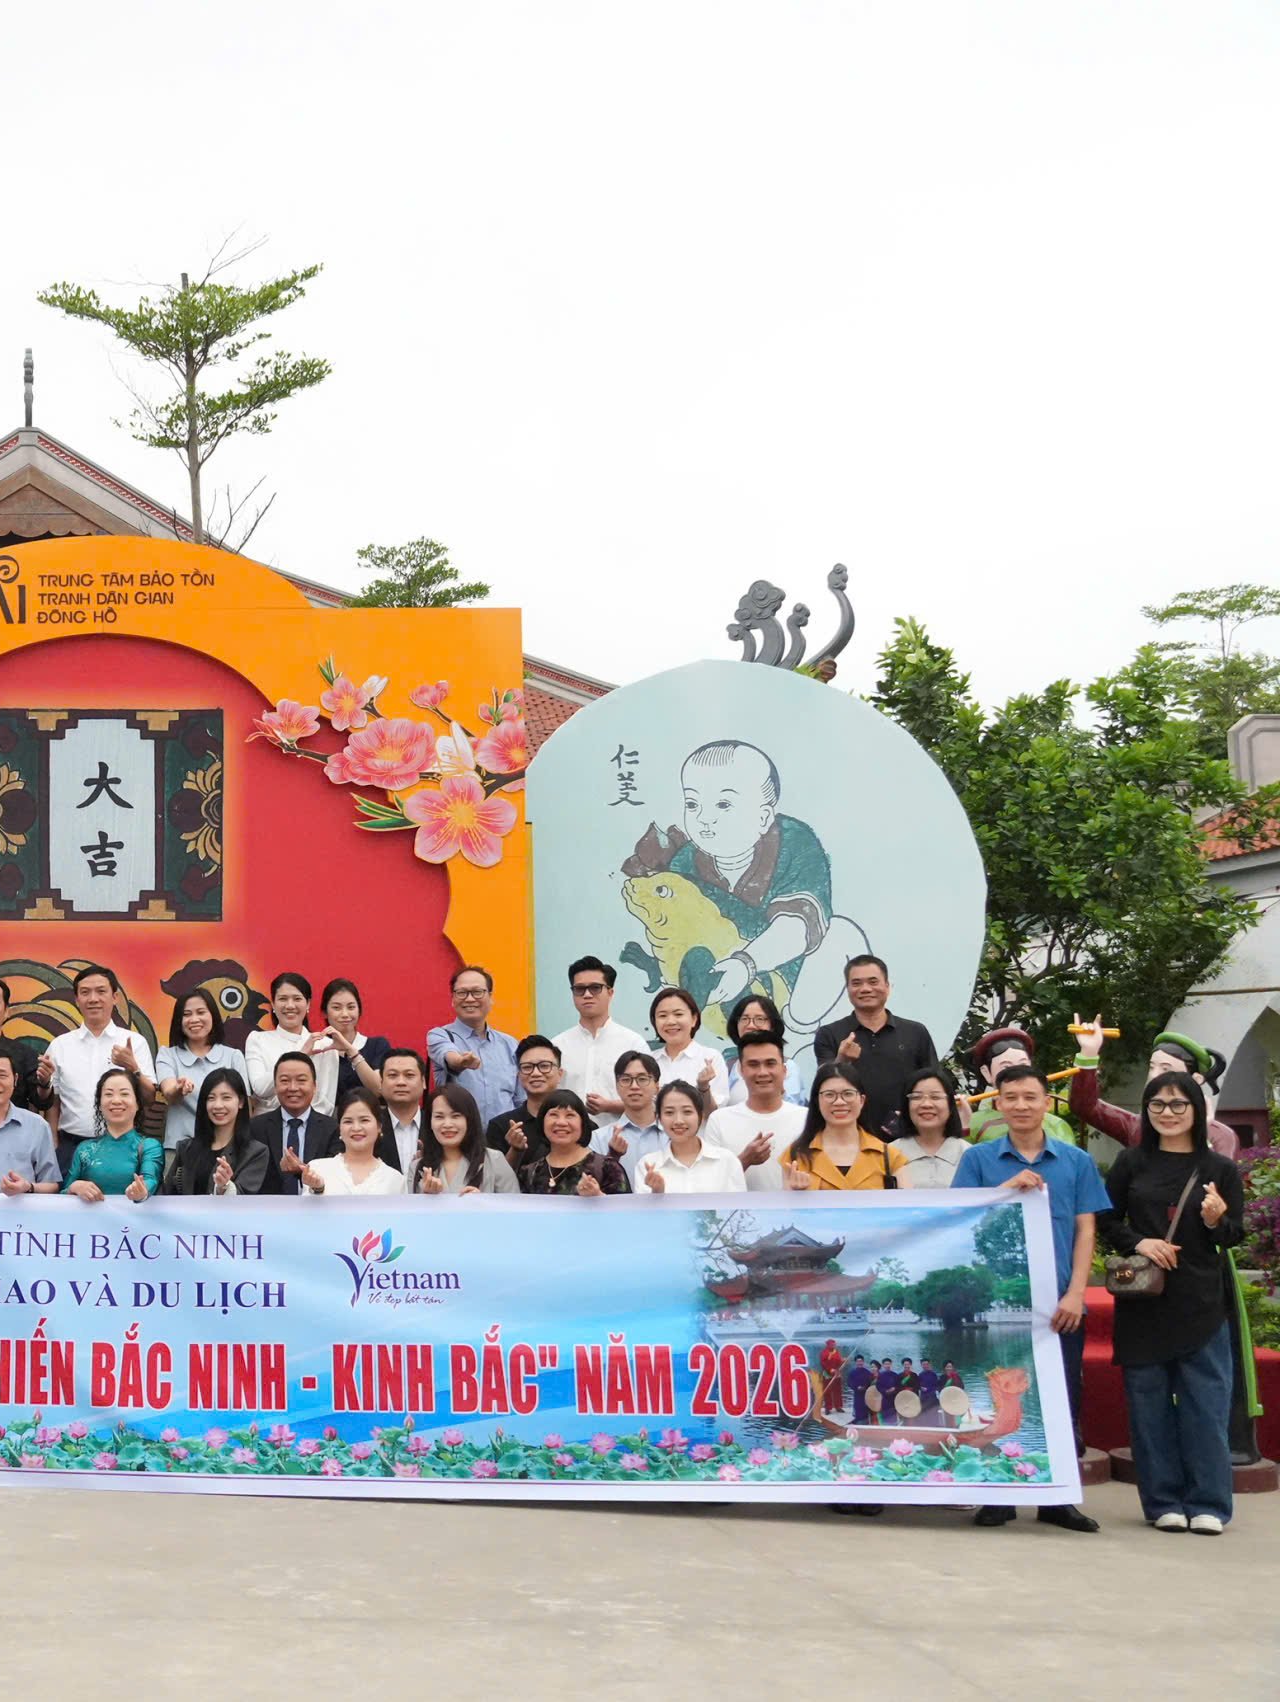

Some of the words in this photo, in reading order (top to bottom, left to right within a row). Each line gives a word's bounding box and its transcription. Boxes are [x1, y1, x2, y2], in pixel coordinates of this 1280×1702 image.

[37, 592, 90, 605] TRANH
[96, 590, 128, 605] DÂN
[134, 591, 174, 605] GIAN
[38, 573, 94, 587] TRUNG
[100, 572, 134, 587] TÂM
[140, 570, 174, 587] BẢO
[180, 568, 215, 587] TỒN
[36, 609, 87, 624] ĐÔNG
[93, 607, 118, 624] HỒ
[75, 761, 135, 878] 大吉
[89, 1225, 162, 1261] BẮC
[172, 1233, 265, 1261] NINH
[70, 1272, 119, 1308] VÀ
[131, 1280, 182, 1308] DU
[194, 1280, 288, 1317] LỊCH
[333, 1252, 461, 1306] Vietnam
[91, 1321, 173, 1410] BẮC
[188, 1341, 287, 1412] NINH
[300, 1375, 319, 1390] -
[332, 1341, 435, 1414] KINH
[449, 1323, 559, 1416] BẮC"
[574, 1332, 675, 1417] NĂM
[688, 1342, 811, 1420] 2026
